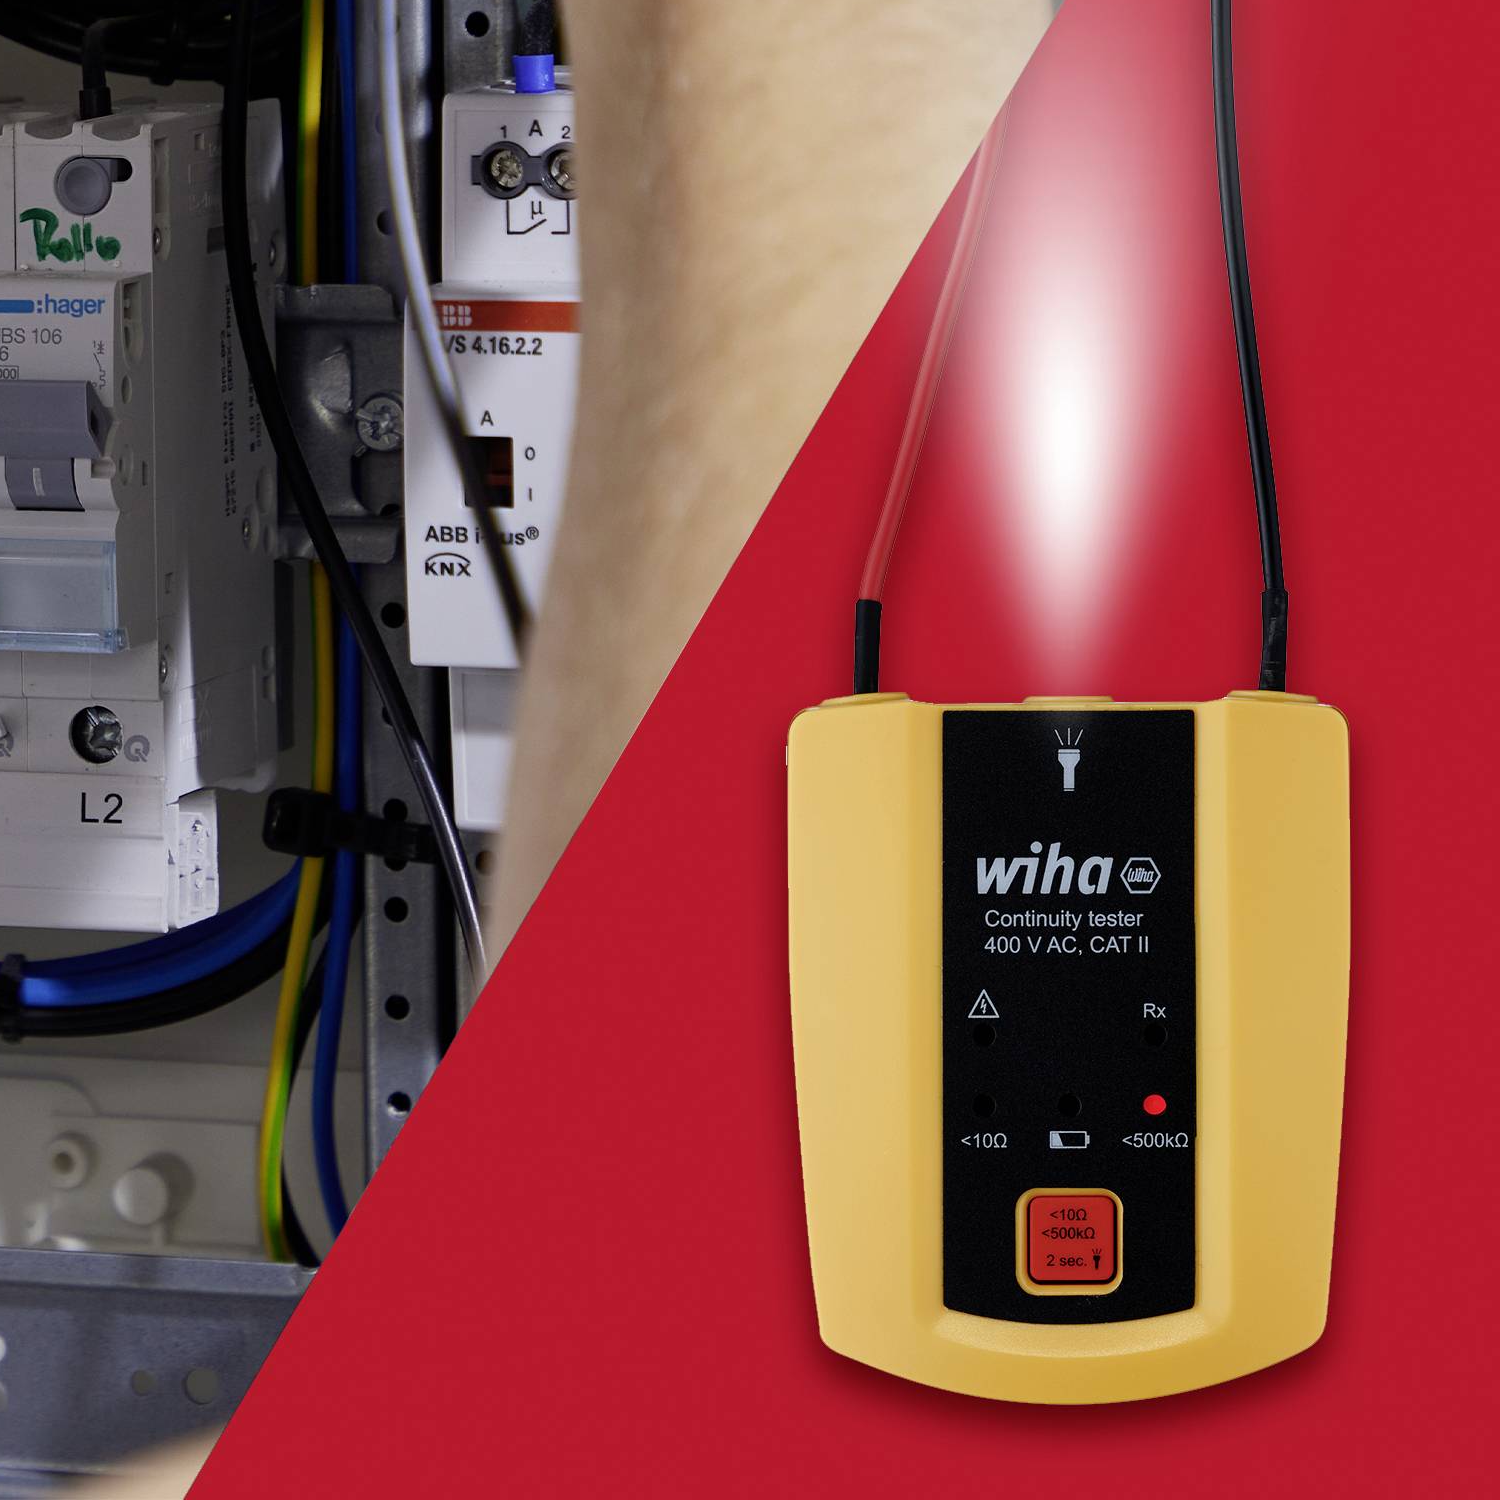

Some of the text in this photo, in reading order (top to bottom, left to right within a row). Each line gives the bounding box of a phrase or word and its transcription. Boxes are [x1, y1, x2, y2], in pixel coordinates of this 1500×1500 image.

[500, 125, 507, 139] 1
[528, 120, 543, 138] A
[560, 125, 571, 140] 2
[442, 305, 473, 327] BB
[31, 328, 62, 345] 106
[472, 335, 543, 356] 4.16.2.2
[480, 410, 495, 427] A
[425, 525, 469, 543] ABB
[425, 560, 471, 577] KNX
[80, 793, 123, 825] L2
[976, 841, 1114, 895] wiha
[984, 909, 1144, 931] Continuity tester
[984, 935, 1149, 955] 400 V AC, CAT II
[1143, 1003, 1167, 1019] Rx
[961, 1132, 1008, 1149] <10Ω
[1122, 1132, 1189, 1149] <500kΩ
[1049, 1208, 1088, 1221] <10Ω
[1041, 1227, 1096, 1241] <500kΩ
[1046, 1254, 1088, 1267] 2 sec.
